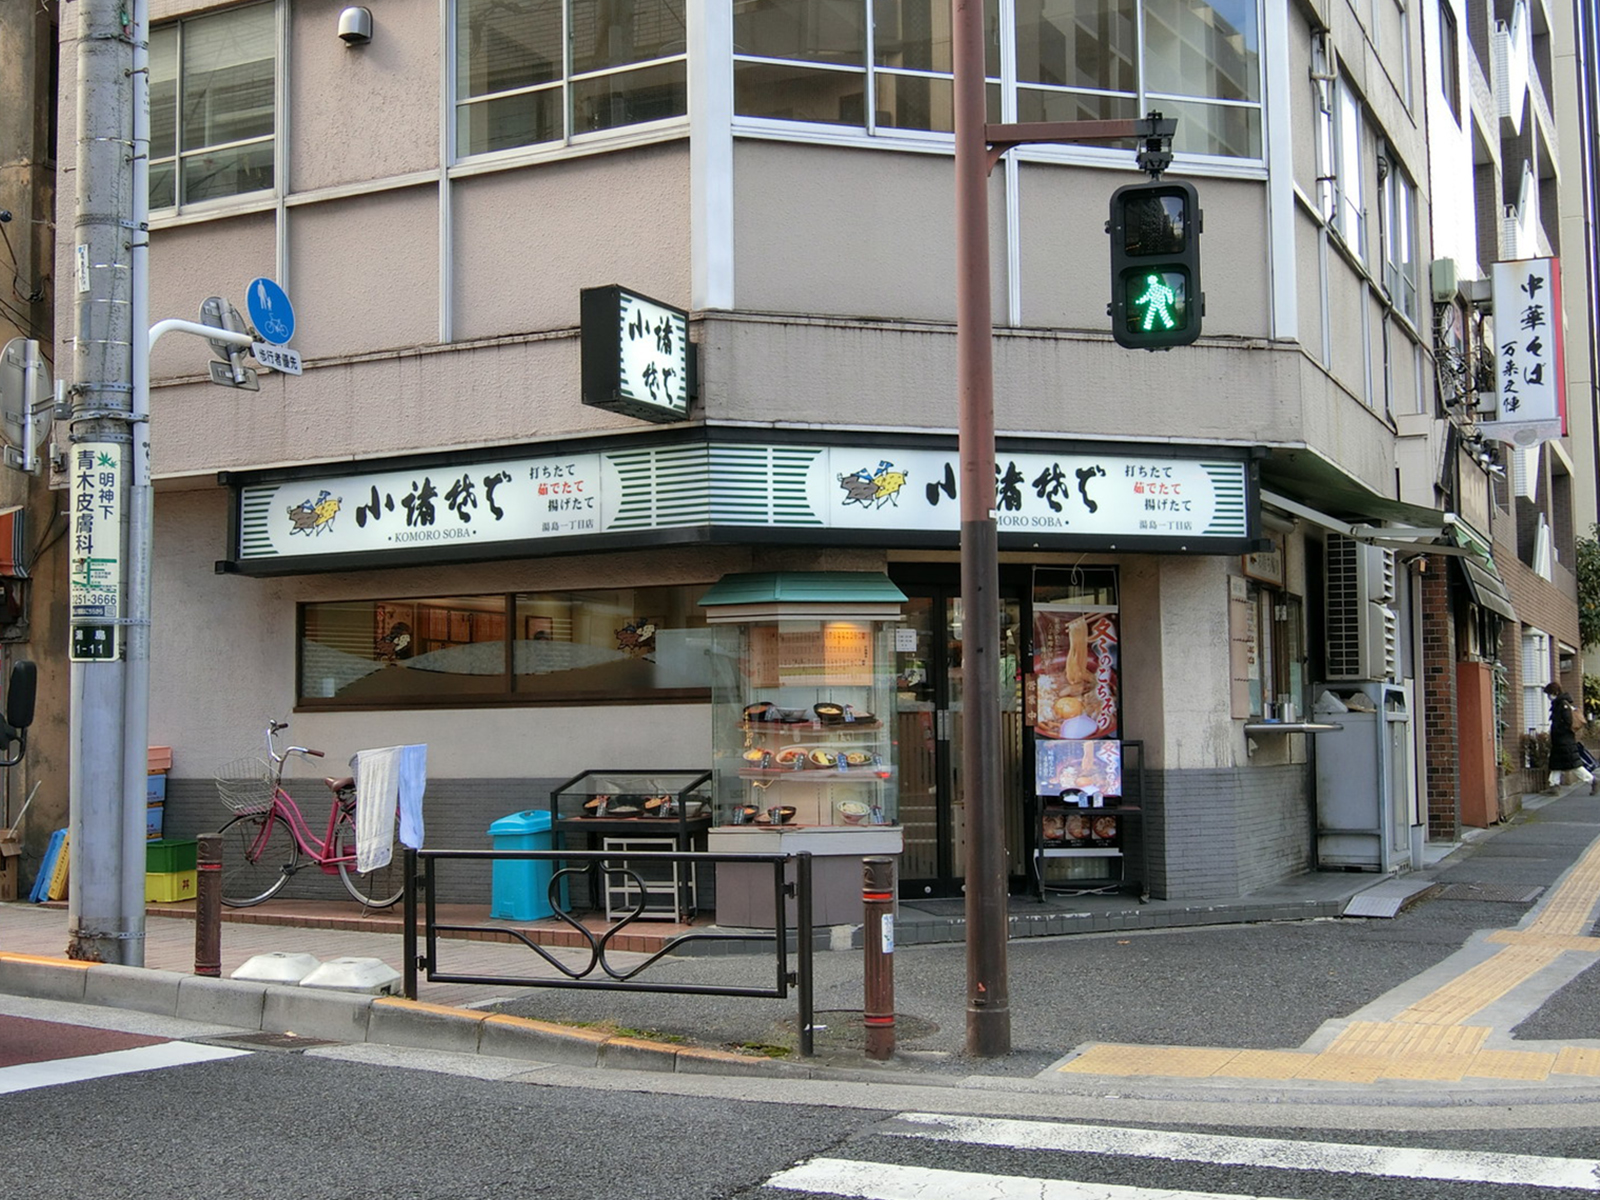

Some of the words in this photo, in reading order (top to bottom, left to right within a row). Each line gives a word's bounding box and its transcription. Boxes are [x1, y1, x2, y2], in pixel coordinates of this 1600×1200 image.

[529, 464, 575, 480] 打ちたて
[1125, 464, 1172, 478] 打ちたて
[538, 480, 584, 496] 茹でたて
[1133, 481, 1181, 495] 茹でたて
[75, 450, 96, 555] 青木皮膚科
[98, 472, 115, 520] 明神下
[548, 496, 594, 512] 揚げたて
[1145, 498, 1192, 512] 揚げたて
[542, 518, 594, 532] 湯島一丁目店
[1031, 516, 1063, 527] SOBA
[1139, 519, 1193, 531] 湯島一丁目店
[394, 530, 441, 543] KOMORO
[442, 528, 470, 540] SOBA
[1087, 618, 1118, 728] 冬のごちそう
